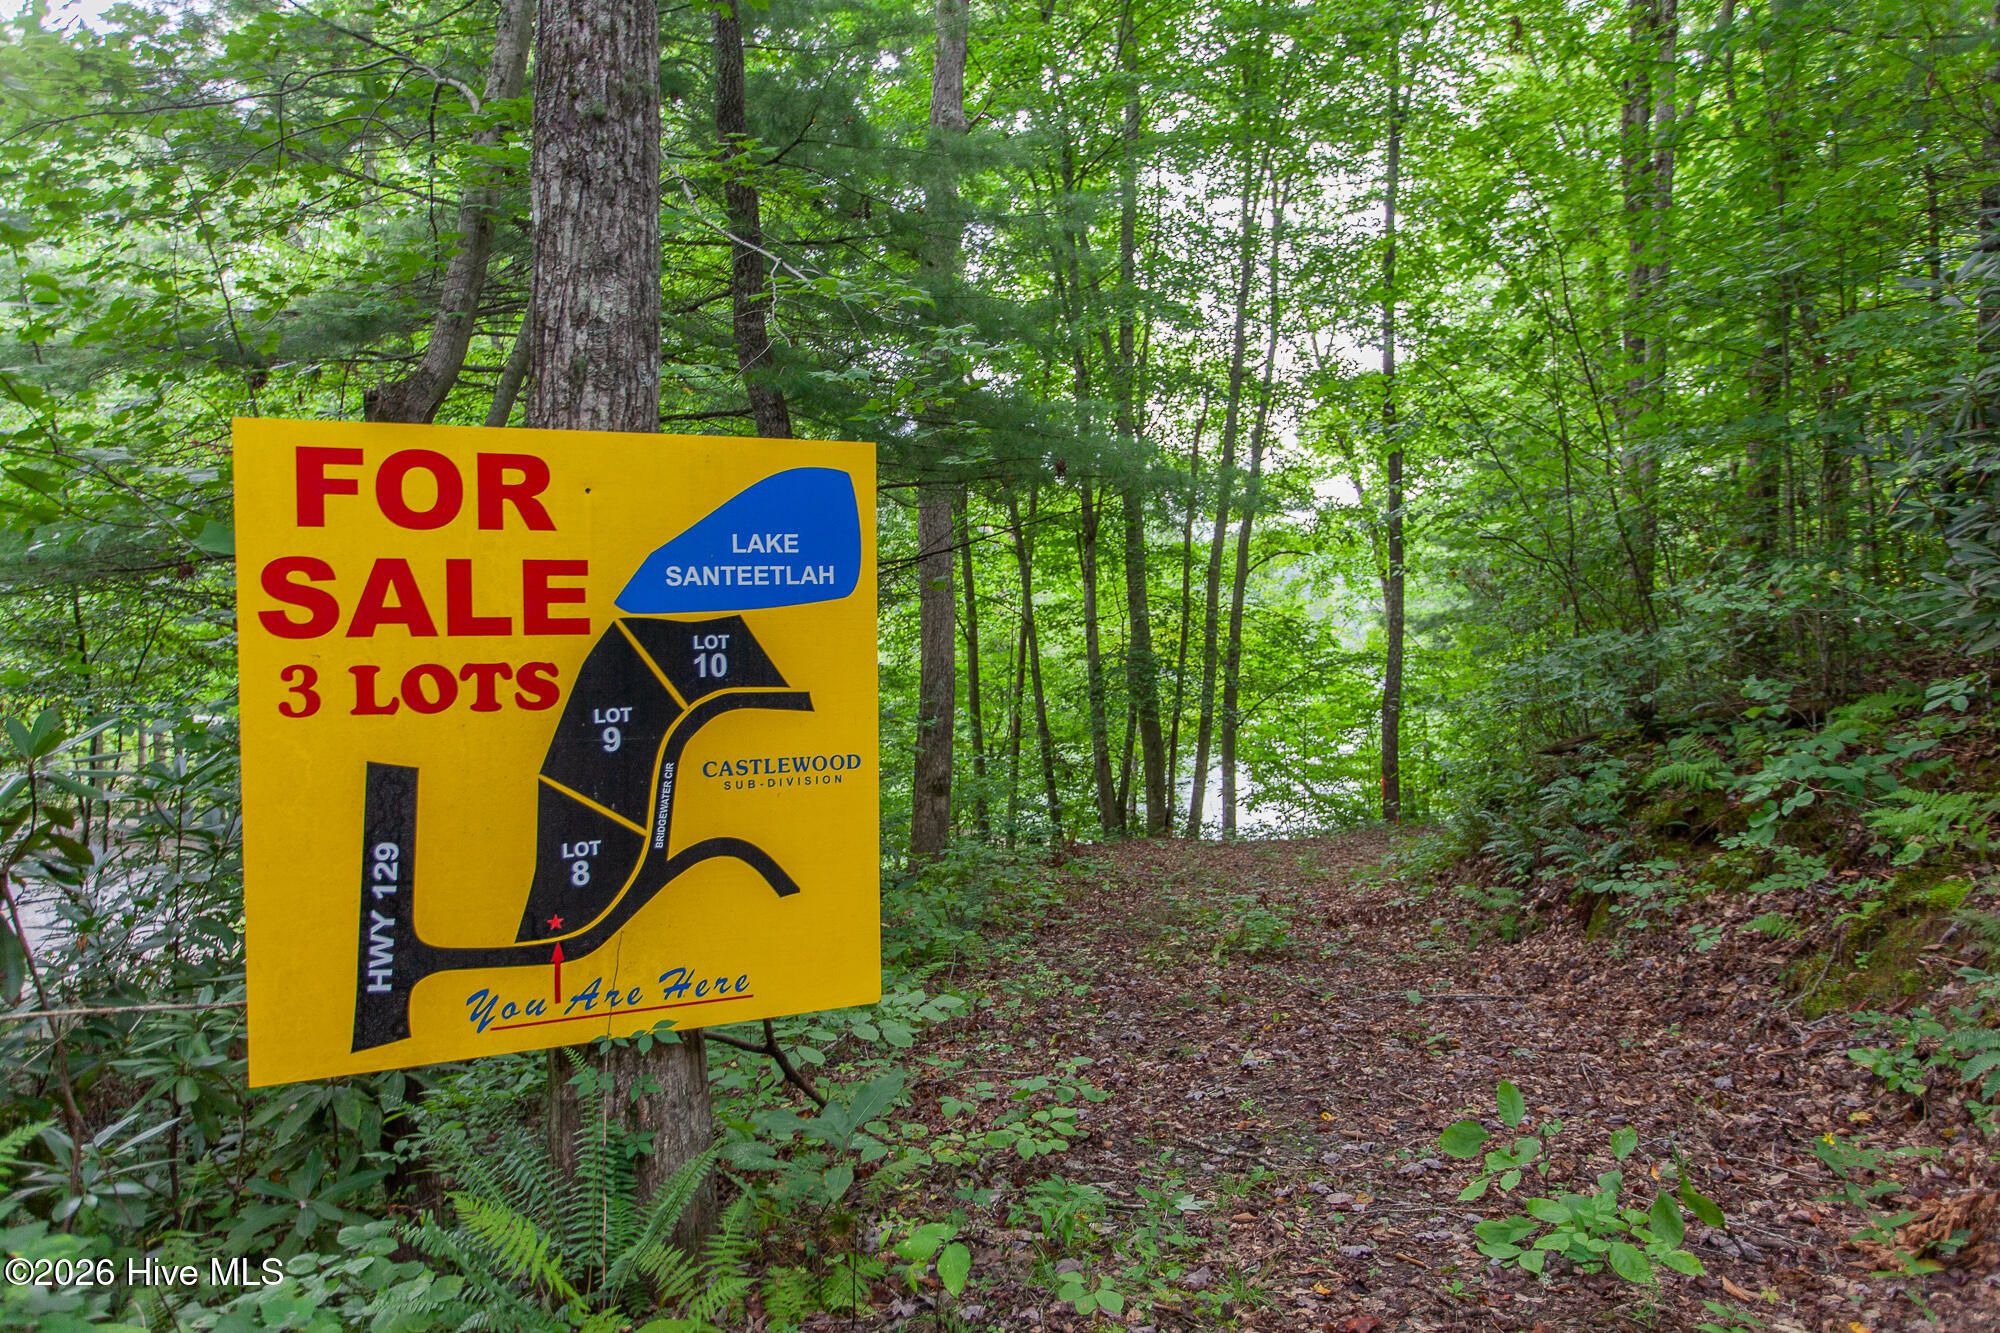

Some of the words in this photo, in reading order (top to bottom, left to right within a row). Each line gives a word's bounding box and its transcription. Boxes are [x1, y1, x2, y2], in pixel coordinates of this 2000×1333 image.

[296, 446, 557, 531] FOR
[732, 533, 800, 554] LAKE
[665, 565, 835, 587] SANTEETLAH
[258, 556, 591, 639] SALE
[692, 634, 730, 650] LOT
[693, 652, 728, 678] 10
[278, 664, 321, 718] 3
[348, 661, 560, 715] LOTS
[593, 706, 633, 724] LOT
[602, 726, 622, 752] 9
[702, 754, 862, 778] CASTLEWOOD
[723, 774, 844, 791] SUB-DIVISION
[654, 780, 673, 849] BRIDGEWATER
[664, 762, 675, 779] CIR
[562, 840, 602, 859] LOT
[370, 841, 400, 900] 129
[571, 860, 591, 887] 8
[367, 909, 396, 994] HWY
[466, 988, 548, 1034] You
[564, 977, 643, 1015] Are
[658, 967, 750, 1000] Here
